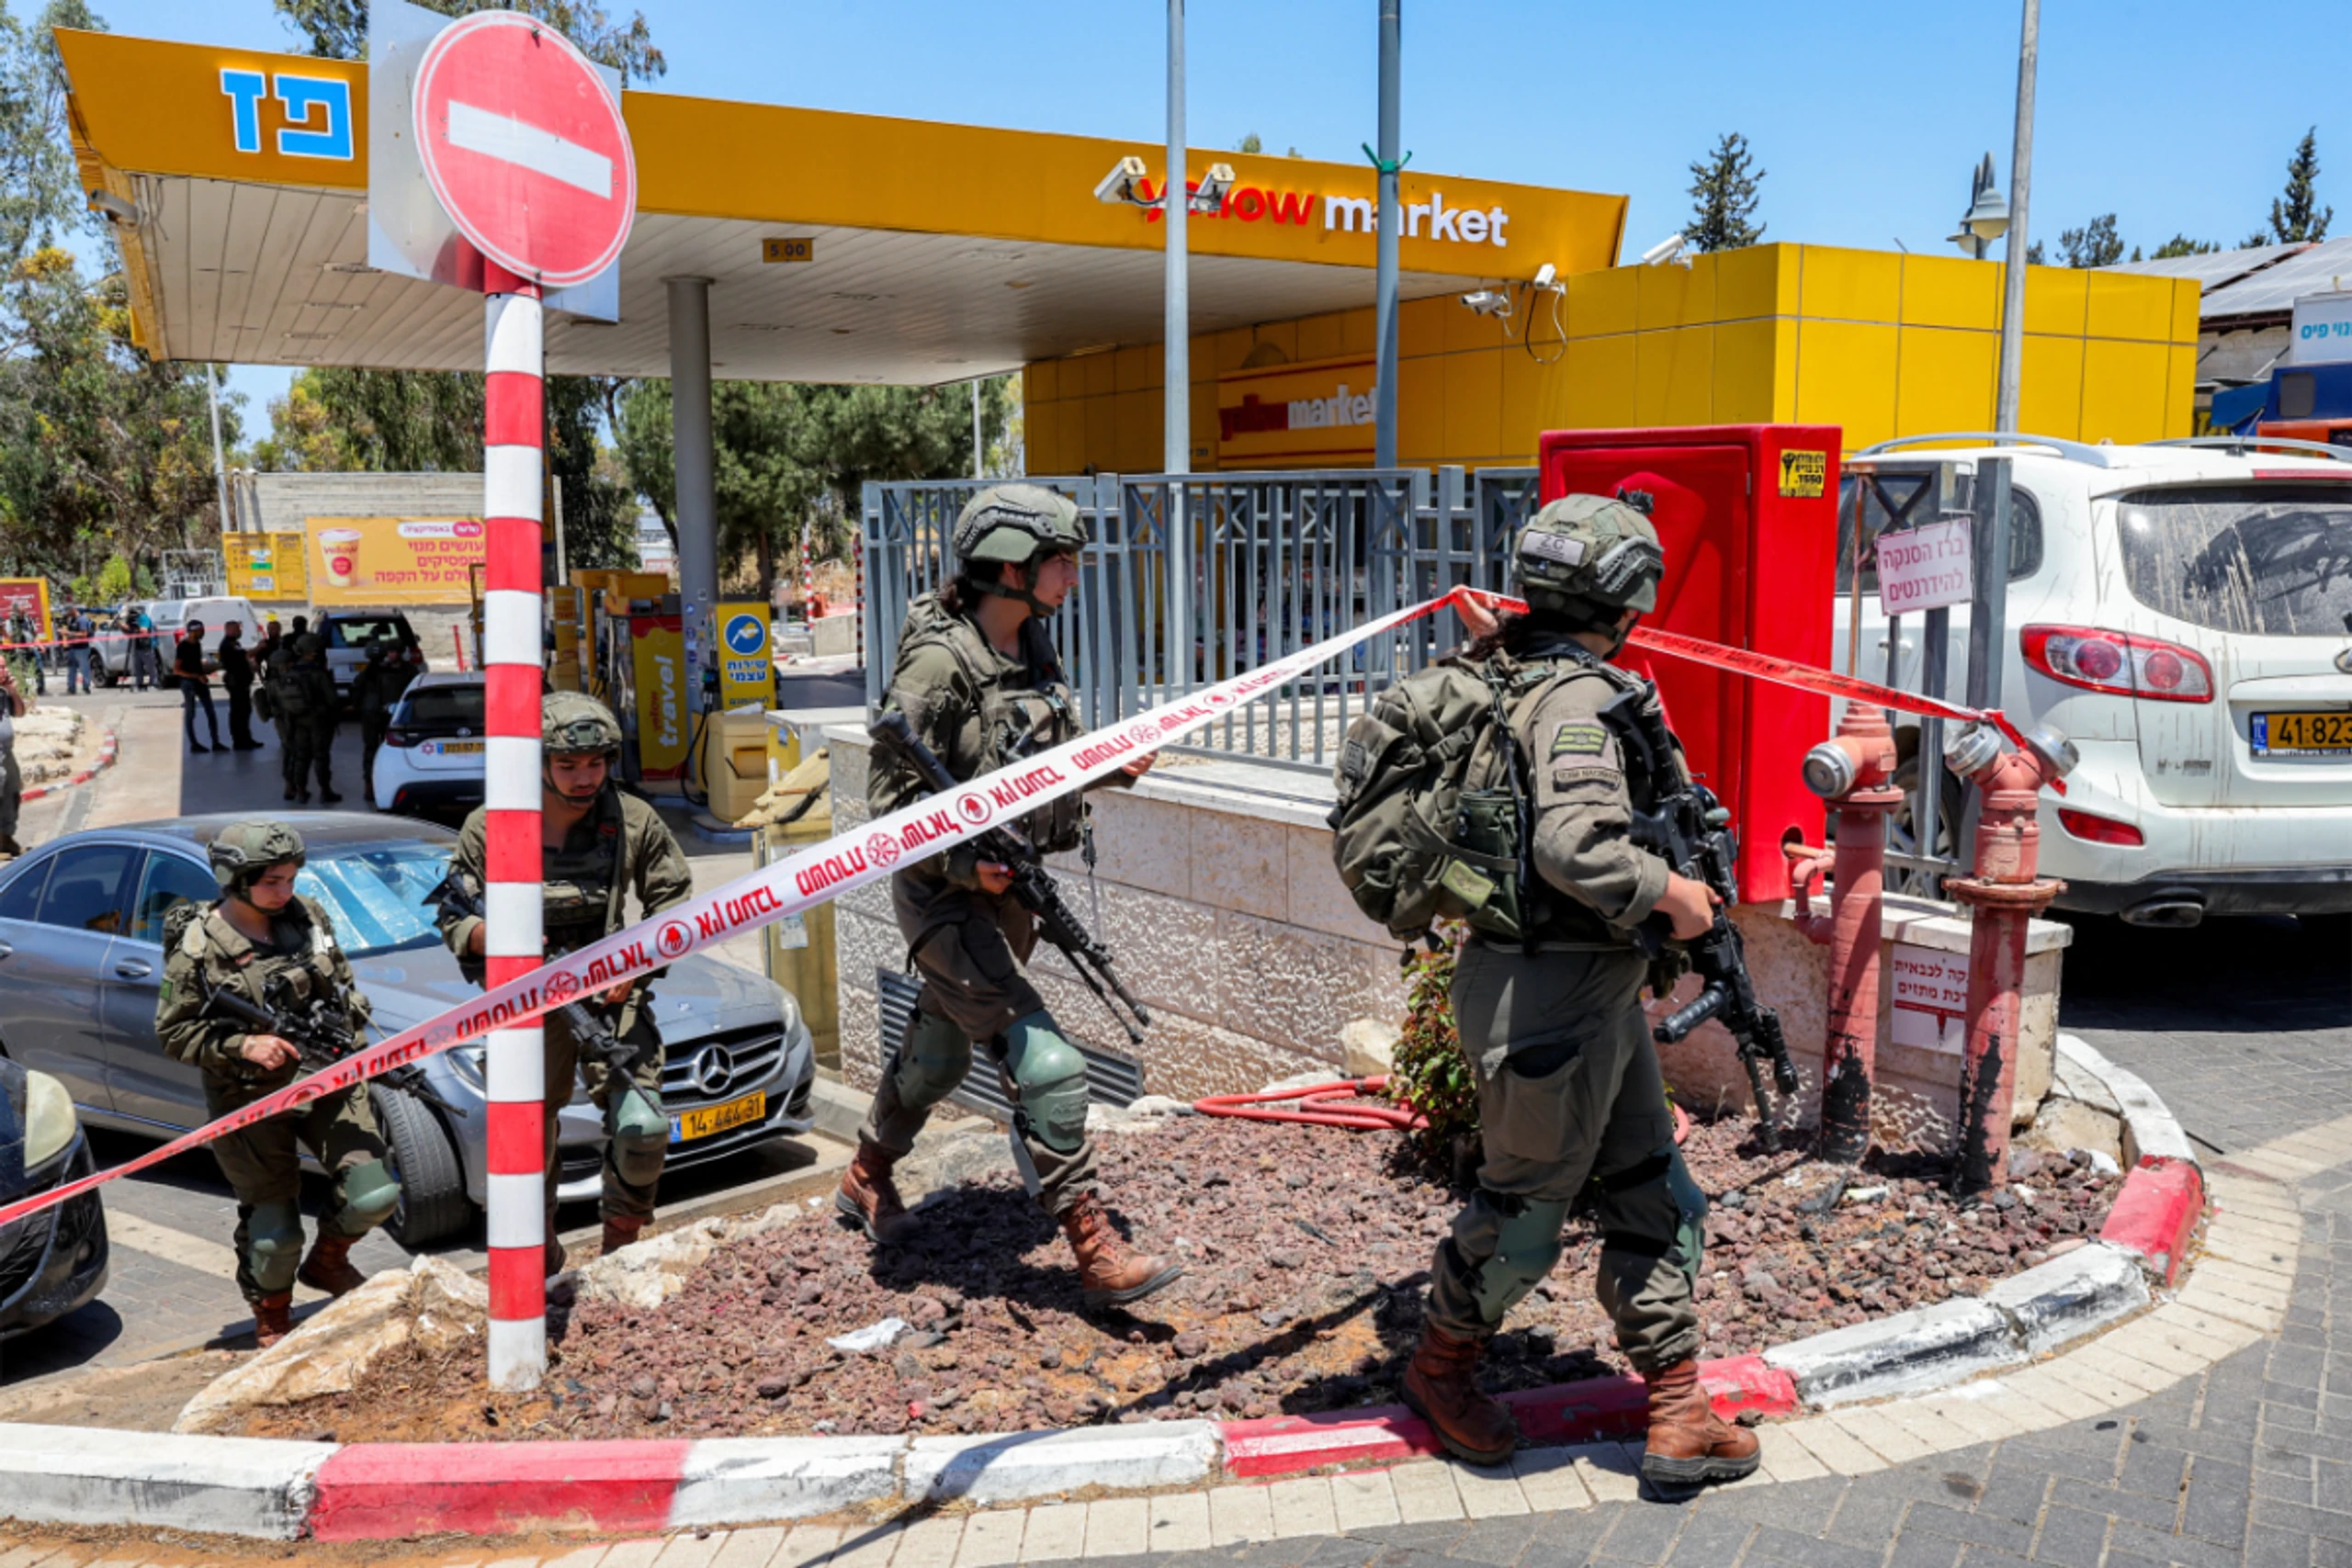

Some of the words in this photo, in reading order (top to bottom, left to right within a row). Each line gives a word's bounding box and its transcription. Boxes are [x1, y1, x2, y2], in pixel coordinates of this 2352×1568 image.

[220, 67, 355, 162] פז
[1139, 177, 1316, 226] ylow
[2301, 323, 2329, 340] פיס
[408, 540, 435, 552] מנוי
[1883, 542, 1932, 571] הסנקה
[421, 569, 440, 581] על
[1889, 568, 1964, 602] להידרנטים
[654, 655, 678, 747] travel
[582, 941, 653, 988] ישראל
[695, 901, 727, 940] אין
[723, 884, 783, 926] מעבר
[796, 845, 867, 897] משטרת
[899, 809, 964, 852] ישראל
[988, 778, 1021, 809] אין
[1012, 765, 1066, 796] מעבר
[1071, 734, 1136, 772] משטרת
[1159, 705, 1215, 731] ישראל
[1894, 959, 1943, 978] לכבאית
